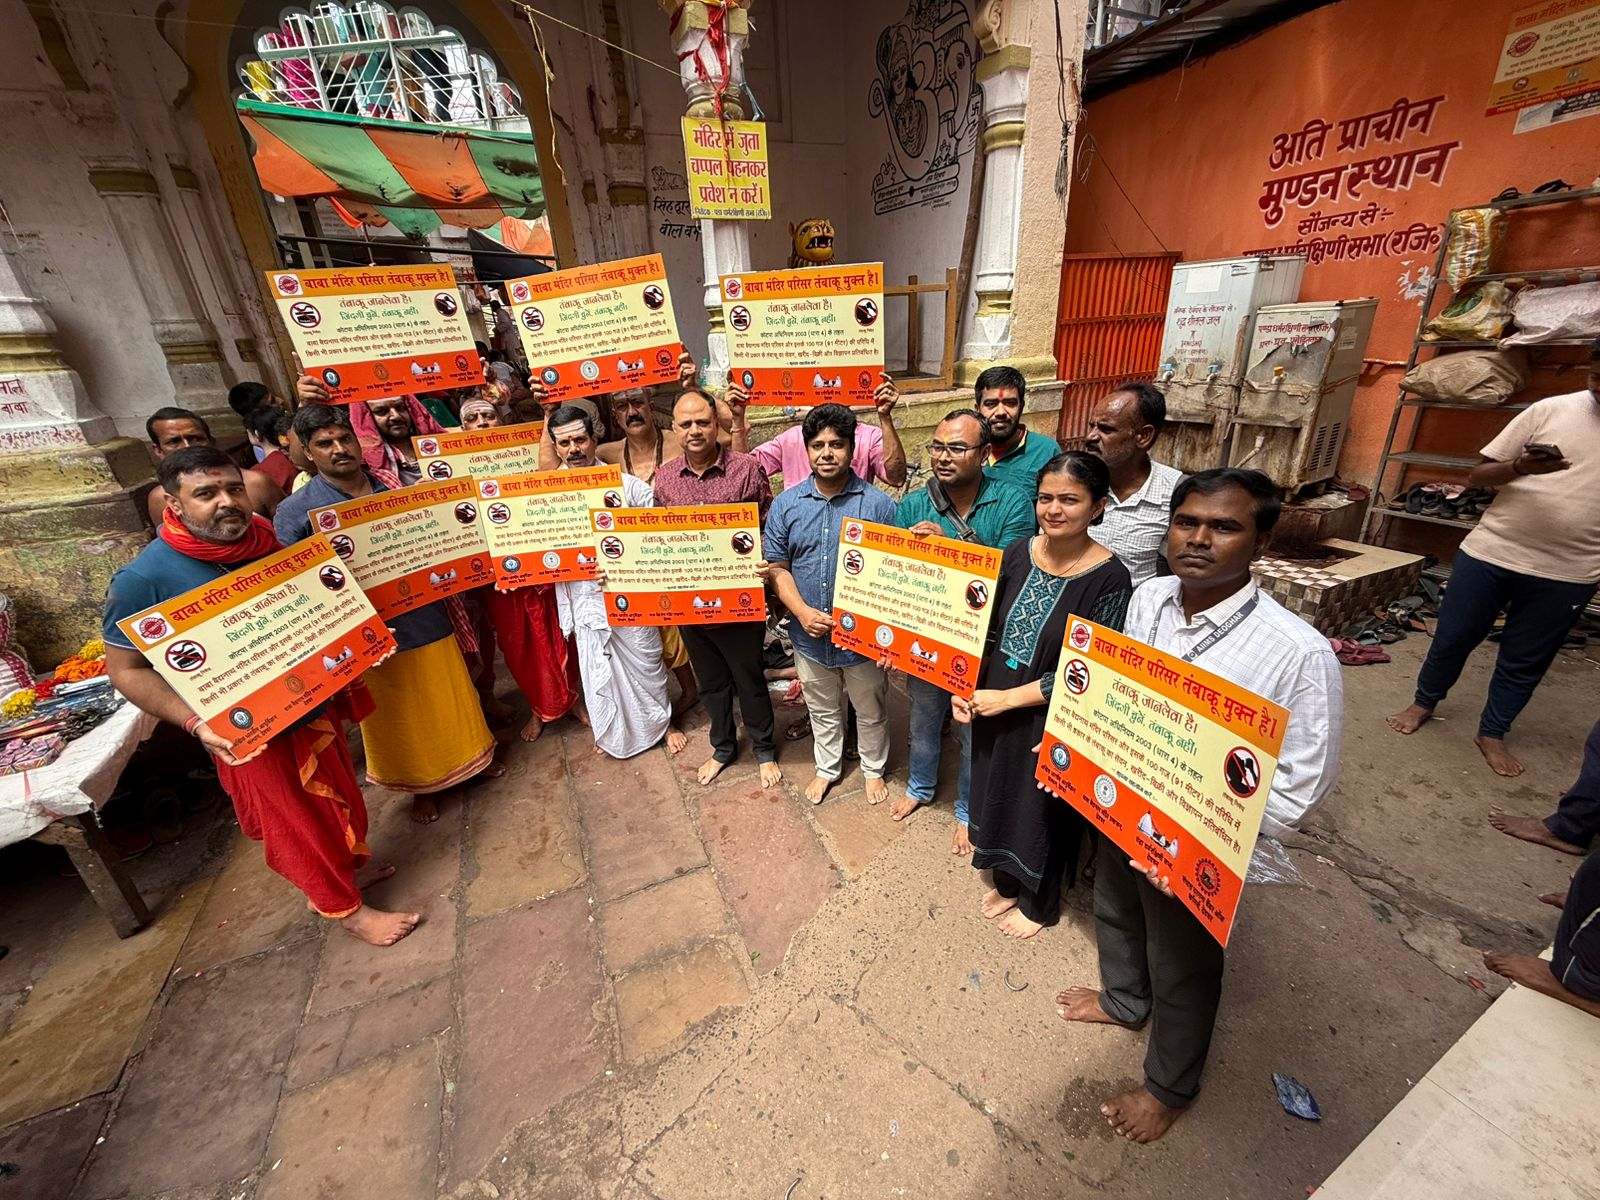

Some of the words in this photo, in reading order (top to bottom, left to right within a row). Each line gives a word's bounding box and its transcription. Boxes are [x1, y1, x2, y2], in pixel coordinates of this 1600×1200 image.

[693, 123, 722, 149] मंदिर
[724, 126, 734, 148] में
[738, 132, 759, 155] जुता
[1269, 119, 1332, 170] अति
[1337, 95, 1446, 152] प्राचीन
[690, 158, 722, 176] चप्पल
[726, 160, 767, 177] पहनकर
[1258, 166, 1345, 226] मुण्डन
[1347, 142, 1459, 199] स्थान
[699, 181, 726, 204] प्रवेश
[728, 188, 737, 203] न
[741, 183, 763, 204] करें।
[1298, 210, 1358, 235] सौजन्य
[169, 600, 204, 621] बाबा
[201, 586, 233, 605] मंदिर
[230, 571, 265, 592] परिसर
[262, 558, 299, 578] तंबाकू
[291, 547, 316, 569] मुक्त
[310, 541, 328, 555] है।
[1197, 636, 1215, 652] AIIMS
[1214, 611, 1244, 637] DEOGHAR
[1094, 636, 1118, 658] बाबा
[1119, 647, 1145, 671] मंदिर
[1146, 659, 1181, 688] परिसर
[1182, 676, 1222, 716] तंबाकू
[1217, 696, 1258, 727] मुक्त
[1258, 706, 1277, 739] है।
